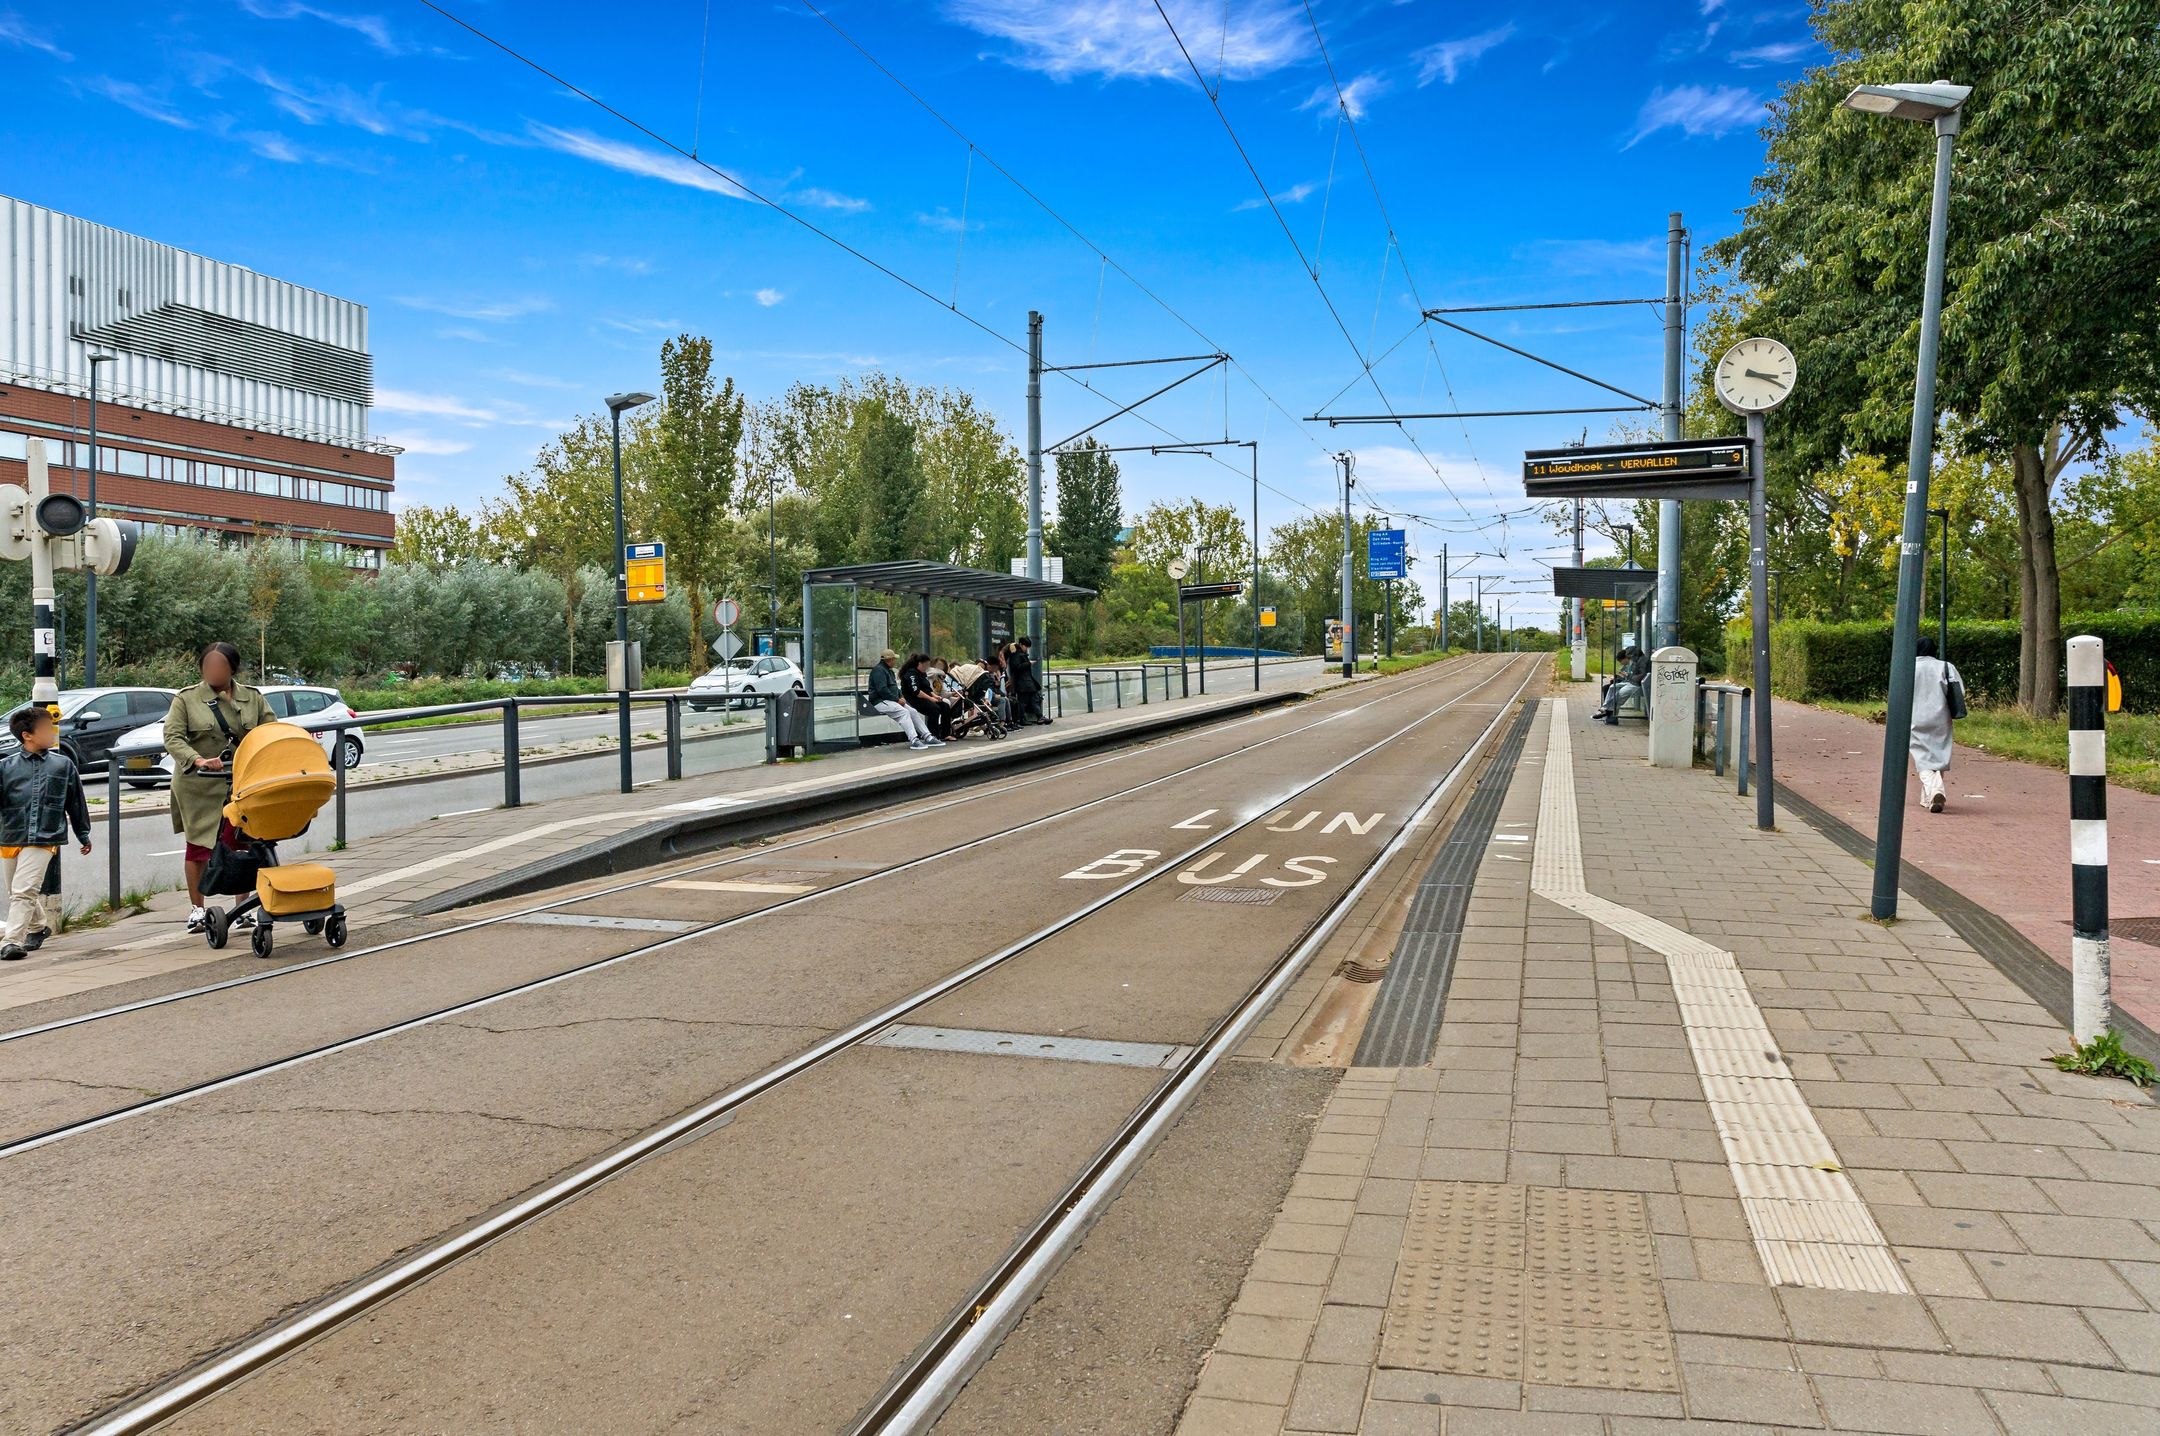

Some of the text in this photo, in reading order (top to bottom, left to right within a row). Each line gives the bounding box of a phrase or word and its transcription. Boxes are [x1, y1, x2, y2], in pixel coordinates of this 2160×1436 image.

[1533, 465, 1545, 475] 11
[1549, 462, 1603, 474] Woudhoek
[1620, 456, 1678, 469] VERVALLEN
[1732, 452, 1741, 462] 9
[1058, 849, 1338, 887] BUS
